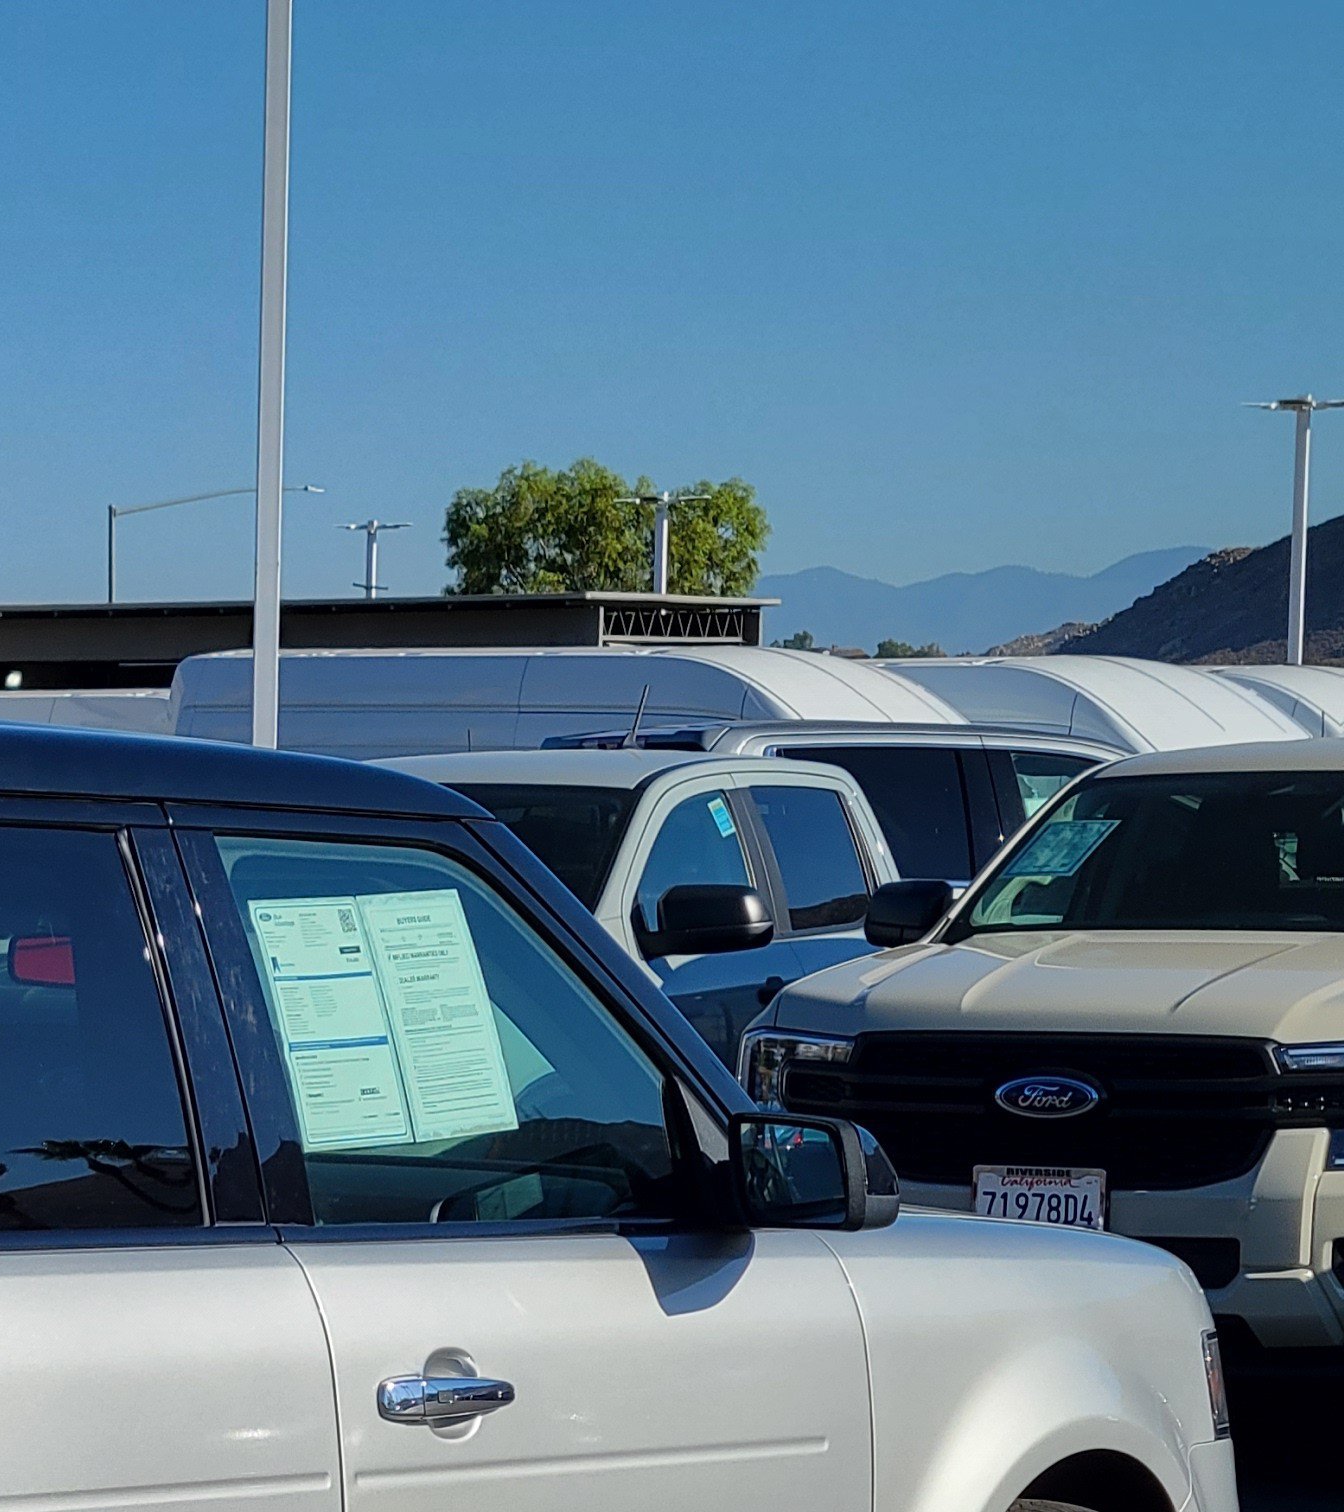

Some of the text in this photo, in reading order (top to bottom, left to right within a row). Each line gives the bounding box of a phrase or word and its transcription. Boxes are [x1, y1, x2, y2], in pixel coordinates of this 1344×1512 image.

[1017, 1084, 1073, 1109] Ford
[1006, 1167, 1072, 1178] RIVERSIDE
[1001, 1175, 1080, 1192] California
[982, 1190, 1094, 1226] 71978D4
